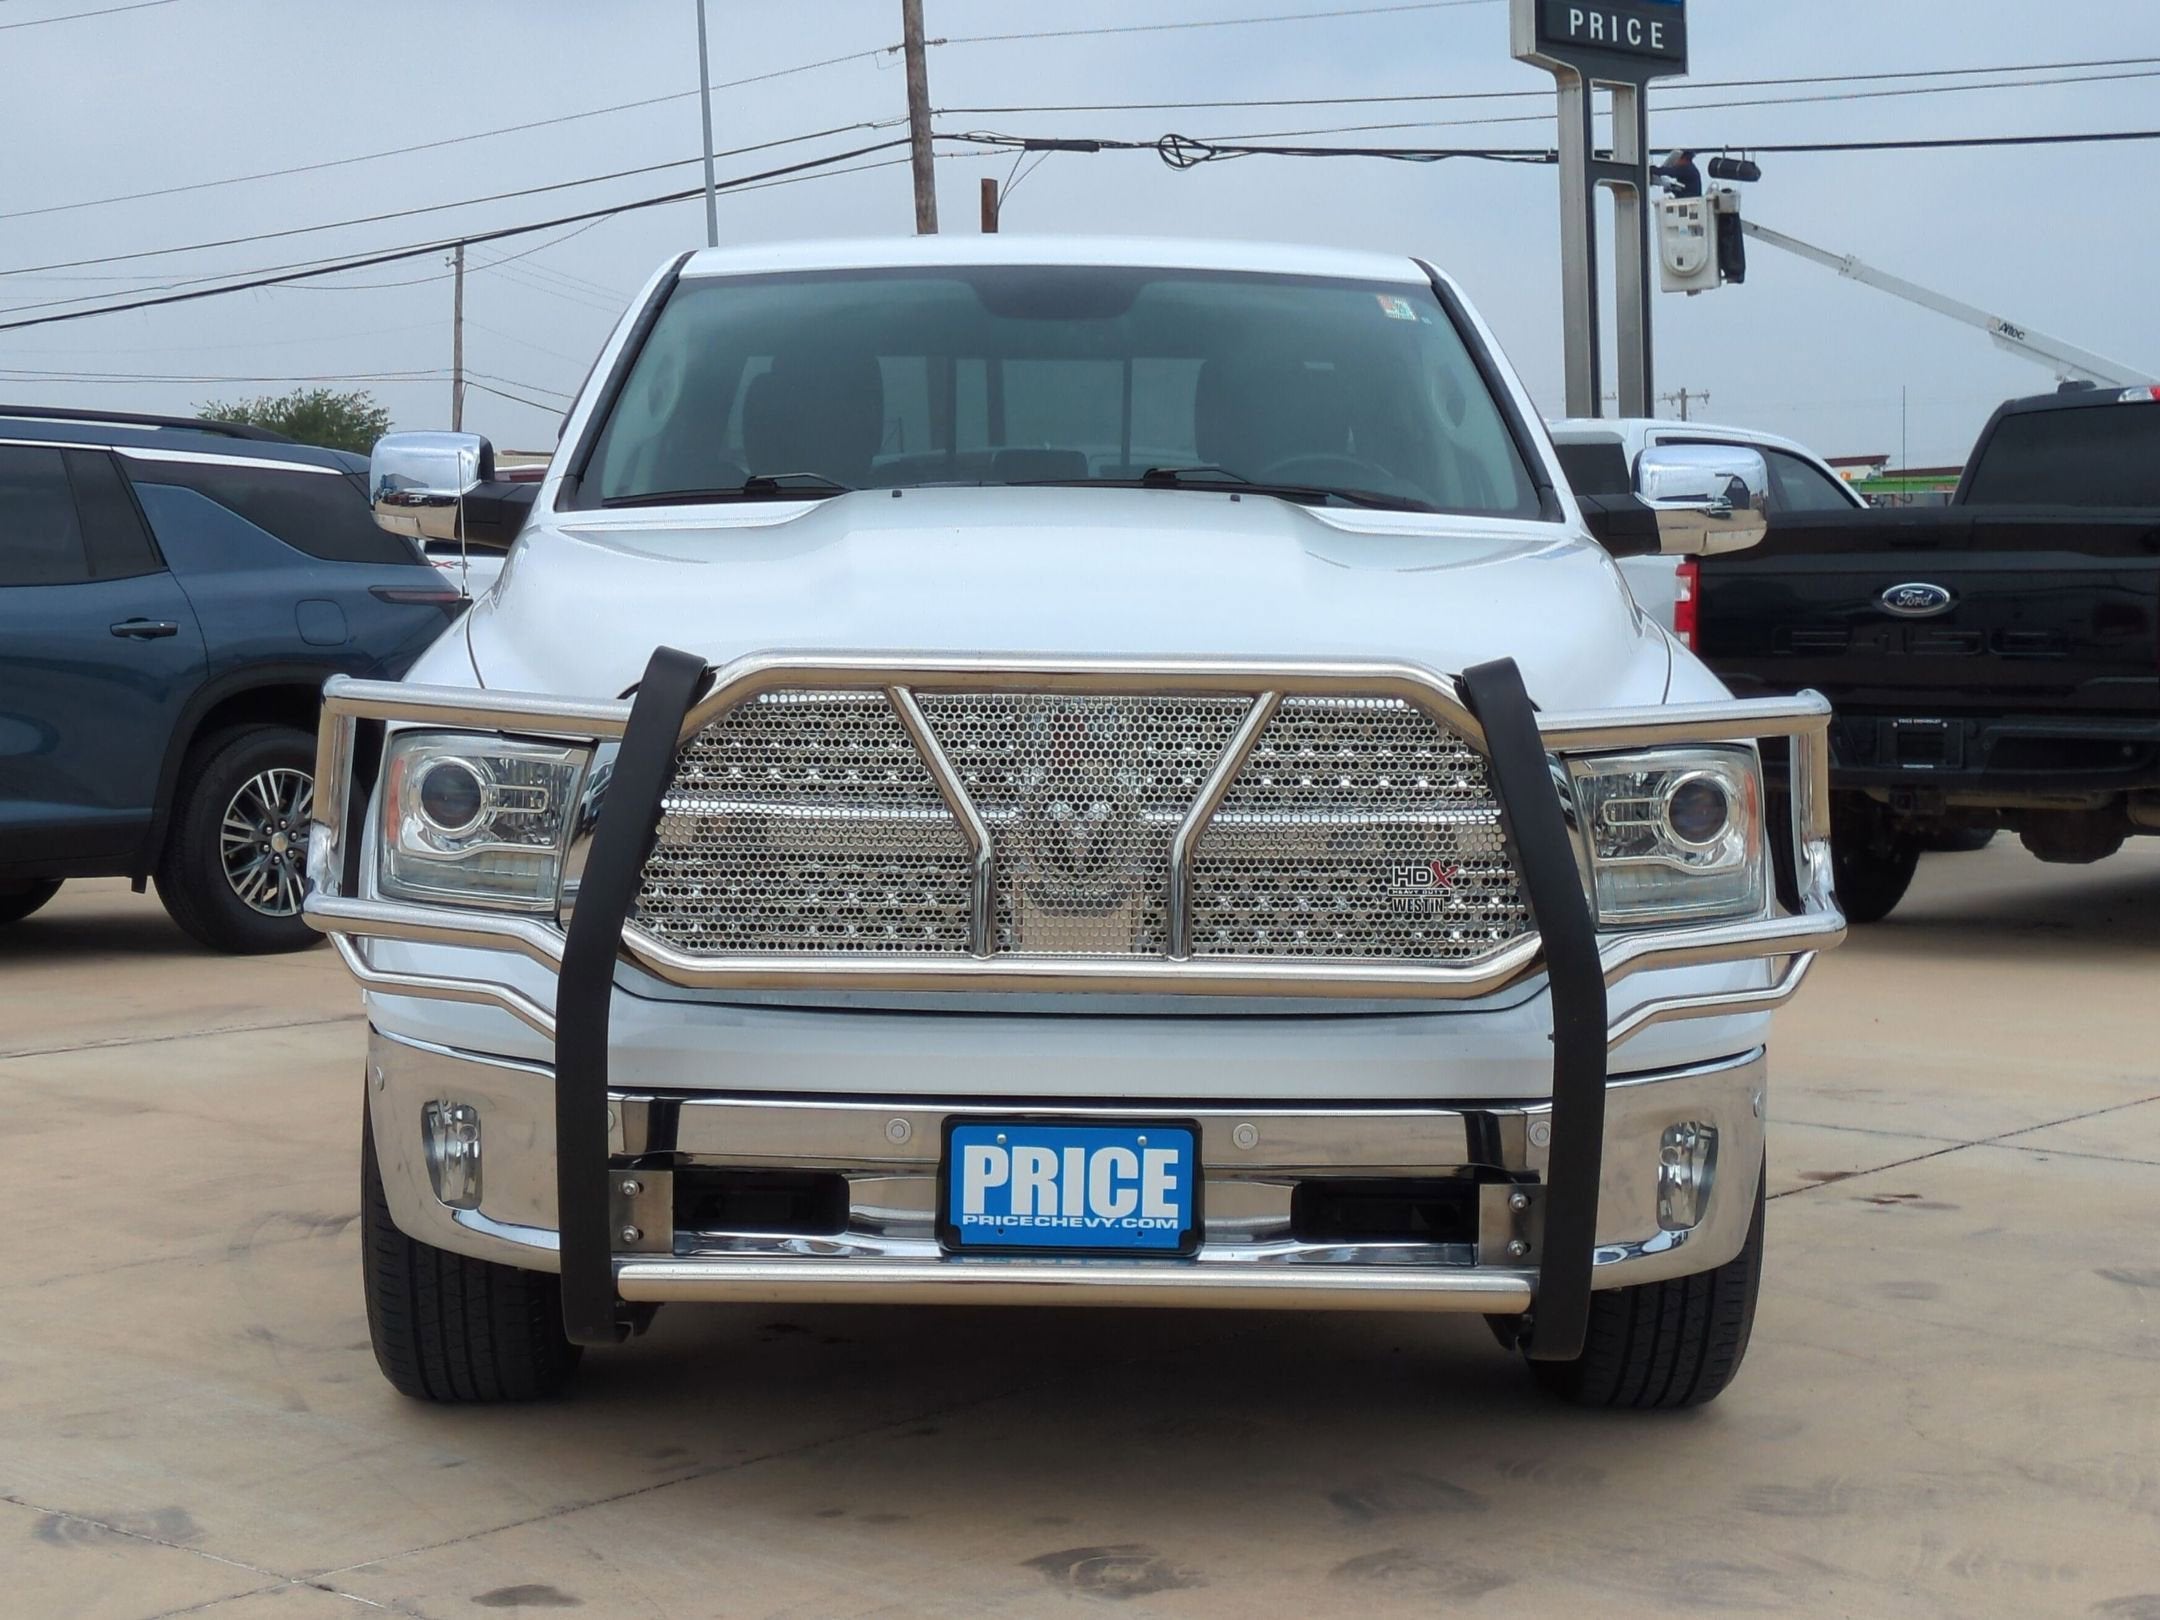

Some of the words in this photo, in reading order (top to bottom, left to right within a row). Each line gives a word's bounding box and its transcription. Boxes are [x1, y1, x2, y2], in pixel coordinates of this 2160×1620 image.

[1569, 8, 1664, 50] PRICE
[1896, 589, 1933, 606] Ford
[1392, 860, 1459, 888] HDX
[1392, 897, 1445, 913] WESTIN
[963, 1144, 1179, 1218] PRICE
[962, 1215, 1179, 1230] PRICECHEVY.COM
